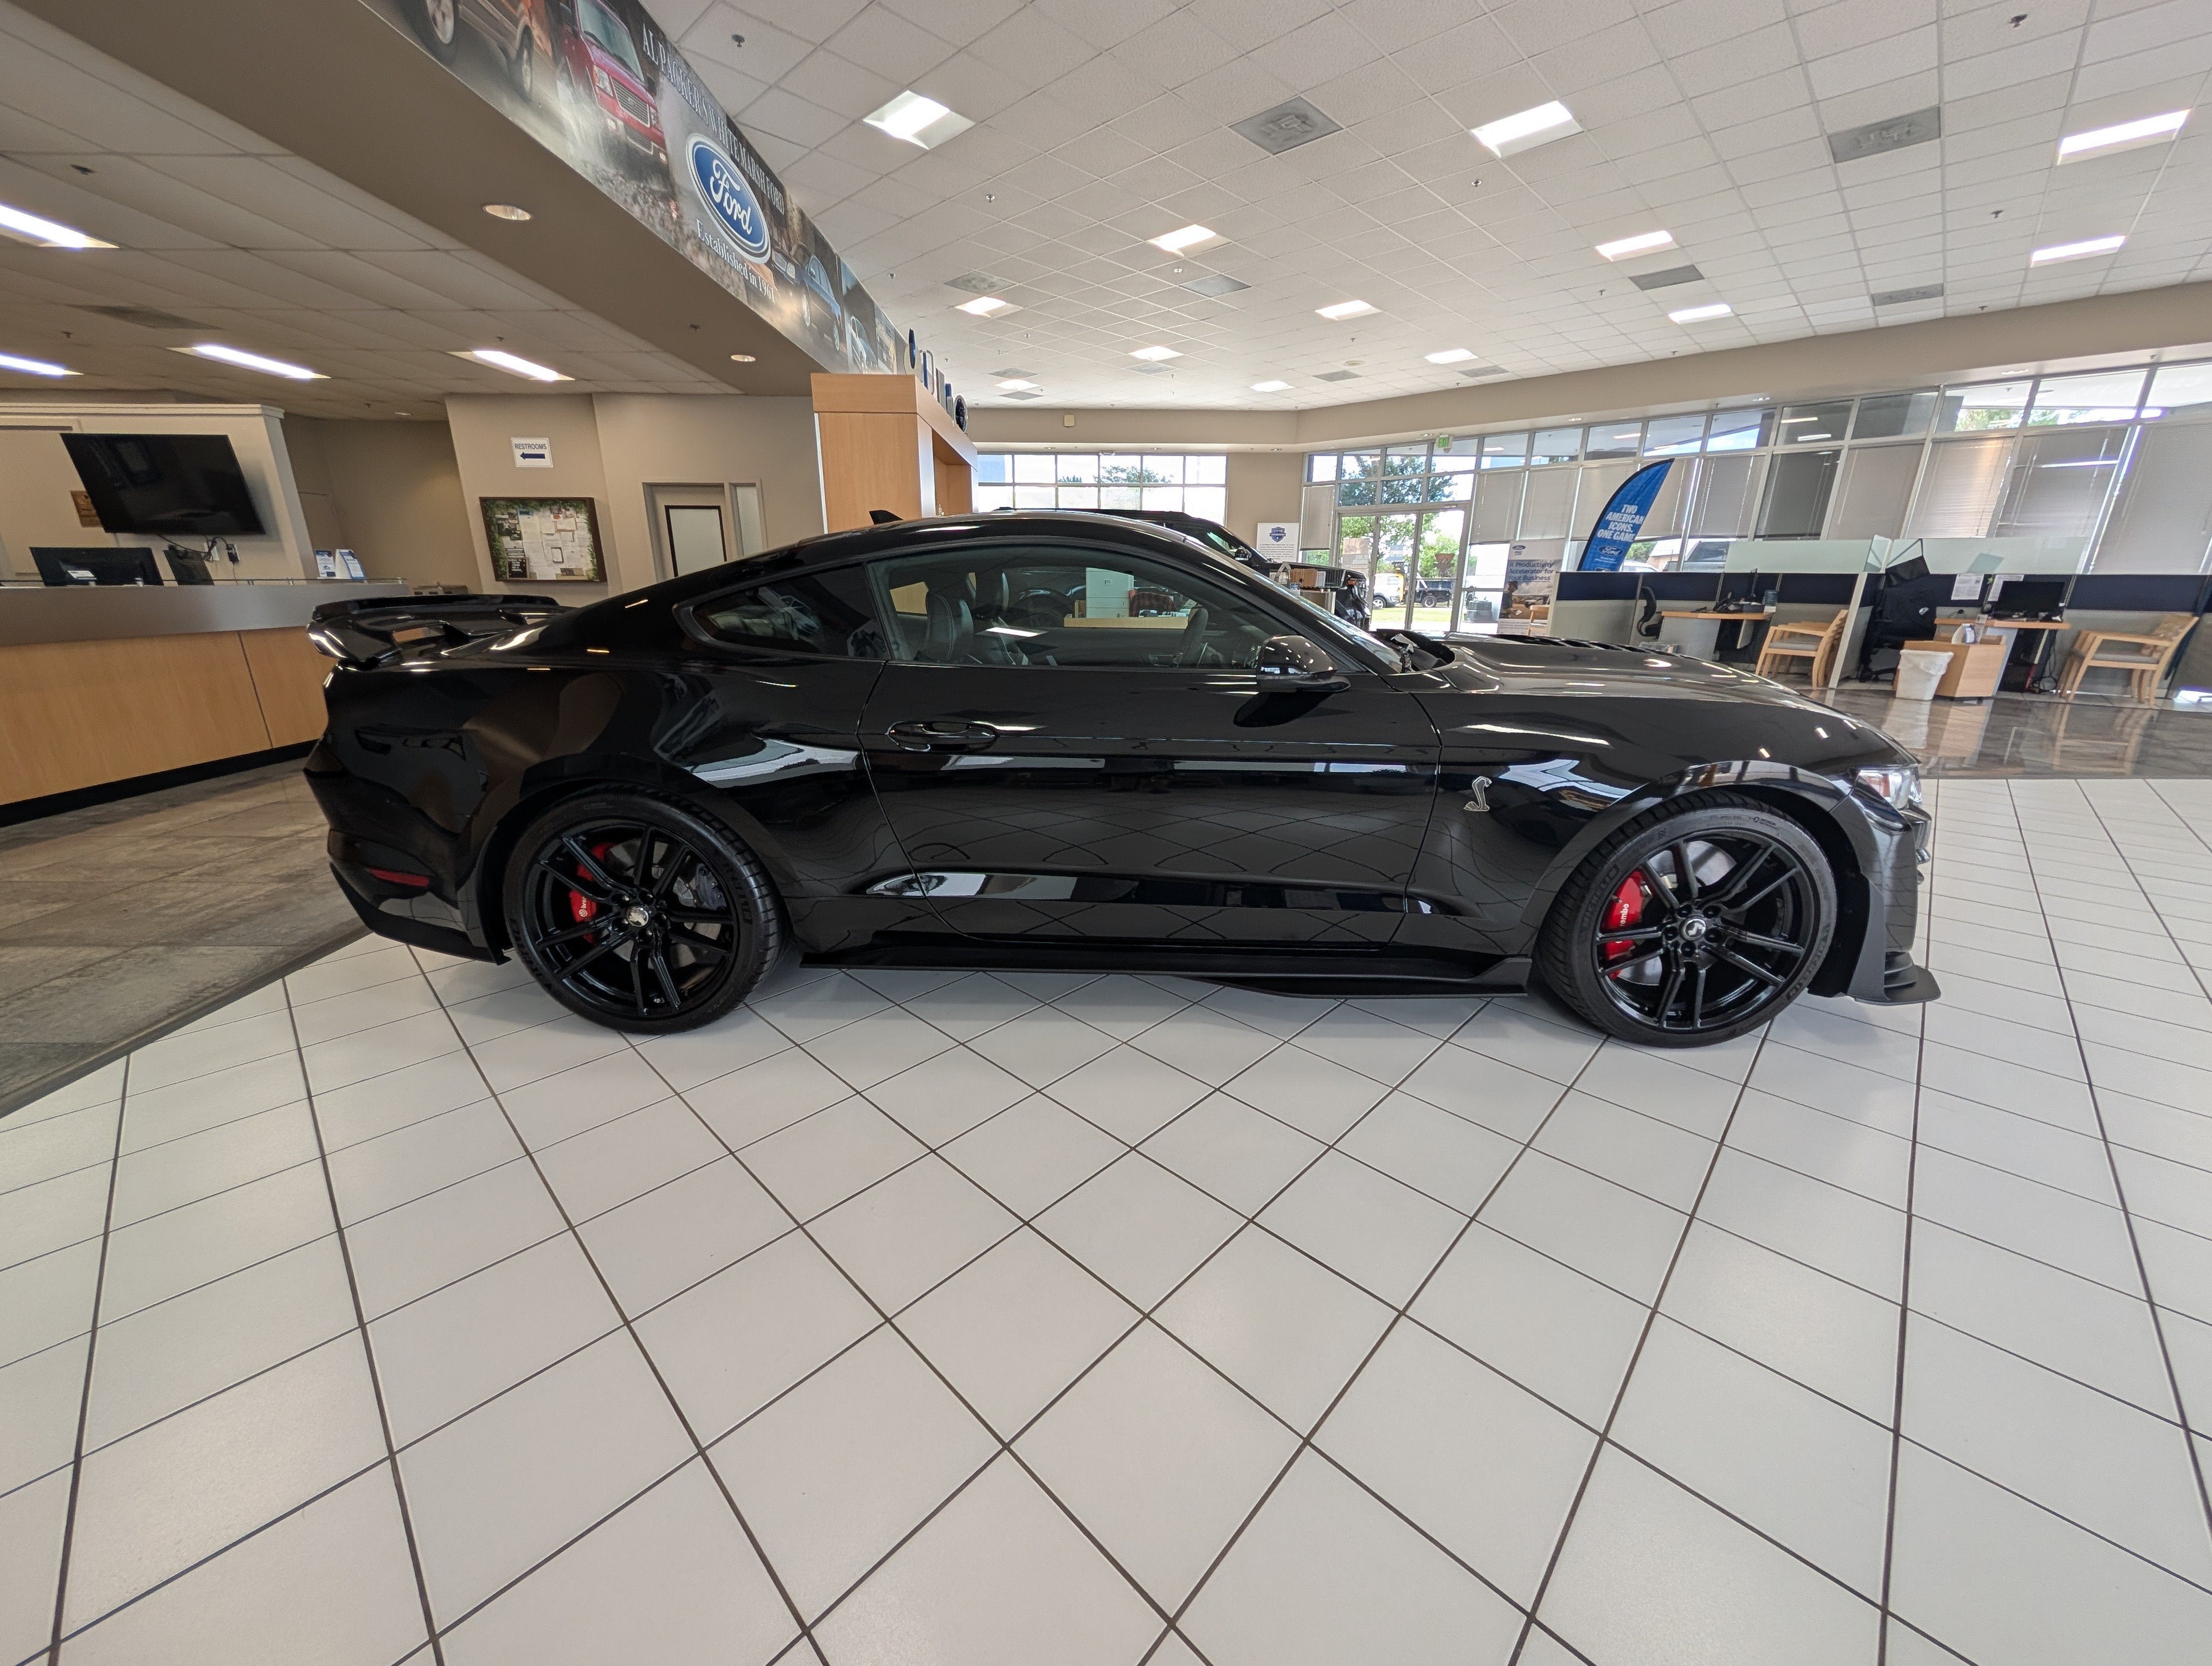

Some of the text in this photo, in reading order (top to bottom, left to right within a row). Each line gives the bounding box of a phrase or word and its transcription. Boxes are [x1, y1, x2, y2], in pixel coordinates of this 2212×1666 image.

[643, 23, 658, 65] AL
[708, 104, 740, 162] WHITE
[739, 142, 766, 194] MARSH
[766, 176, 785, 215] FORD
[710, 159, 753, 234] Ford
[696, 218, 775, 303] Established in 1961
[1621, 504, 1638, 514] TWO
[1608, 521, 1633, 533] ICONS.
[1597, 529, 1636, 542] ONE GAME
[1602, 546, 1620, 555] Ford
